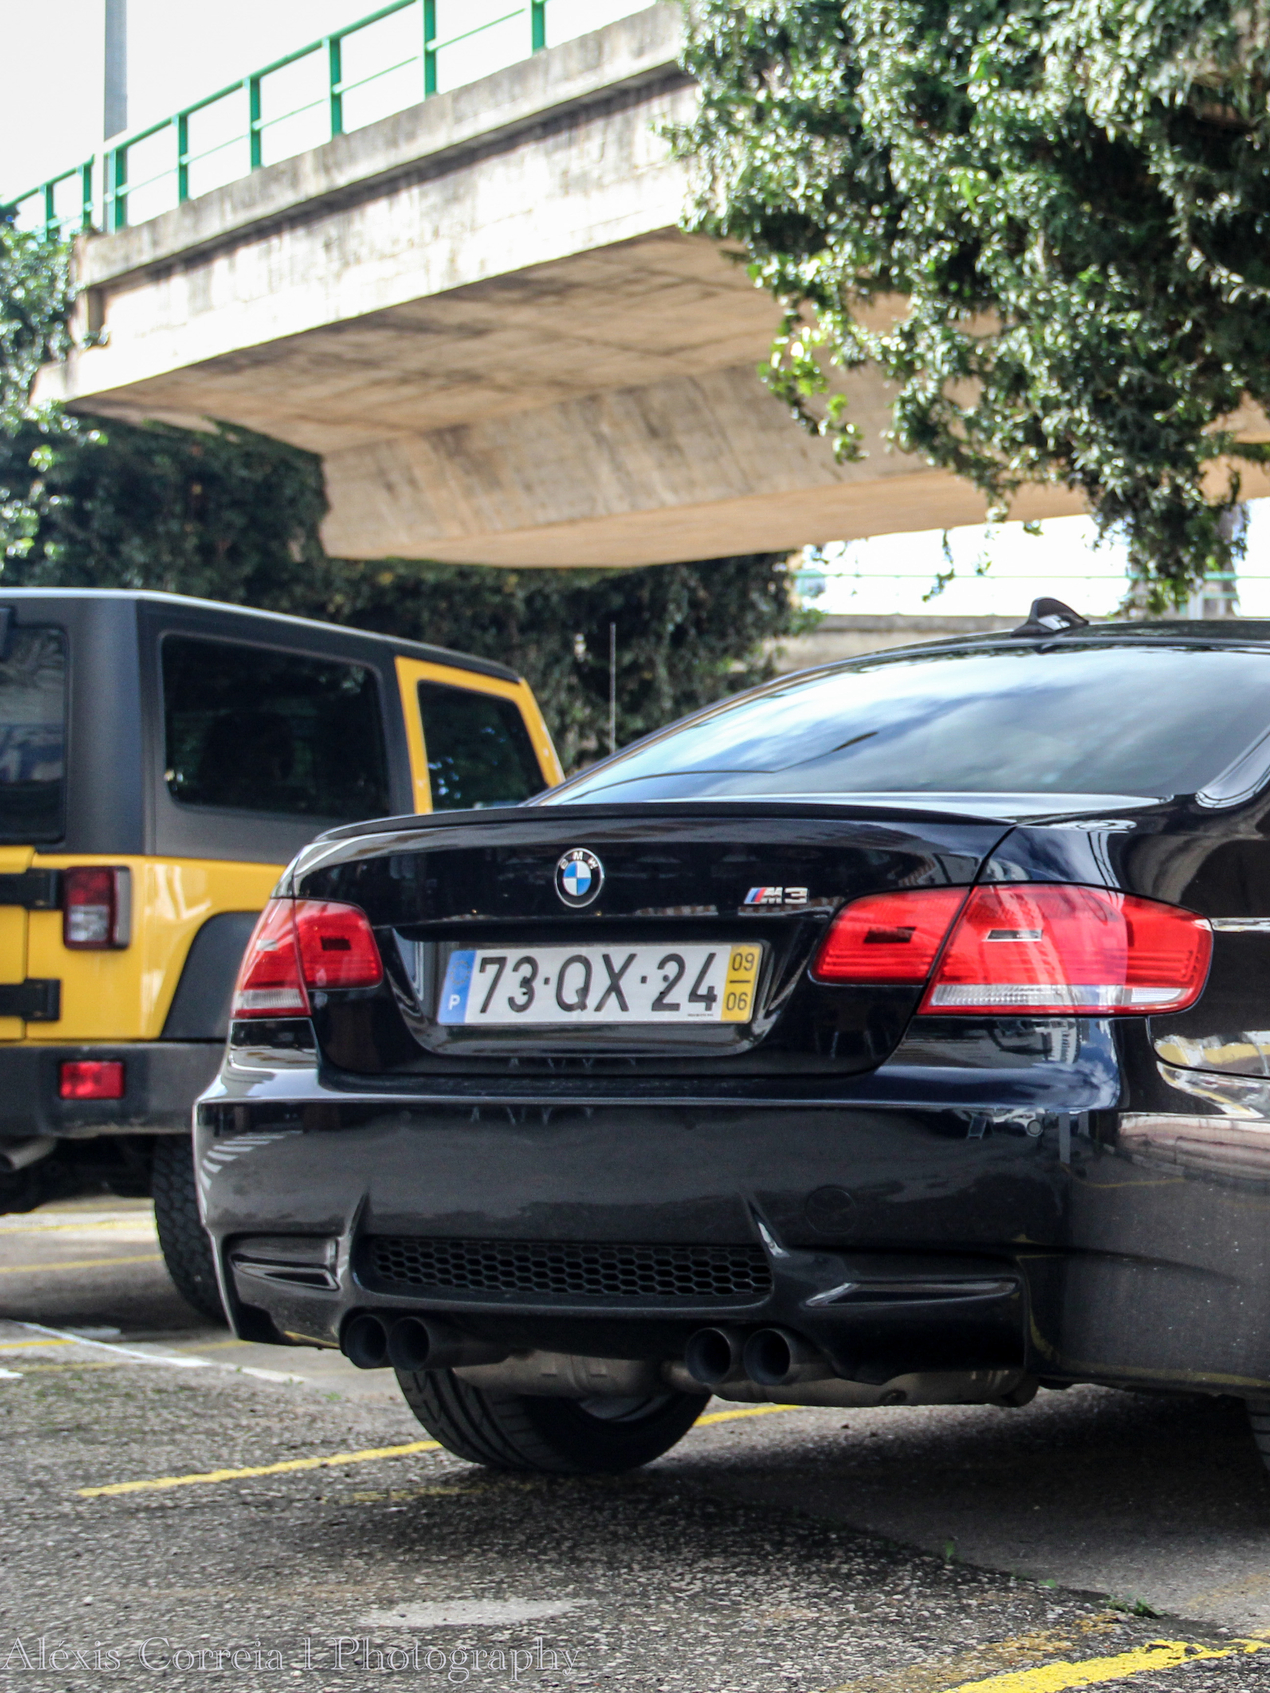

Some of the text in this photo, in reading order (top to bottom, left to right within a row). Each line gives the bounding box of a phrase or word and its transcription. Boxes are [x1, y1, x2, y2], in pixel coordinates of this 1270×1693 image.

[560, 851, 599, 869] BMW
[744, 887, 808, 904] M3
[732, 952, 755, 972] 09
[448, 994, 461, 1011] P
[726, 992, 749, 1011] 06
